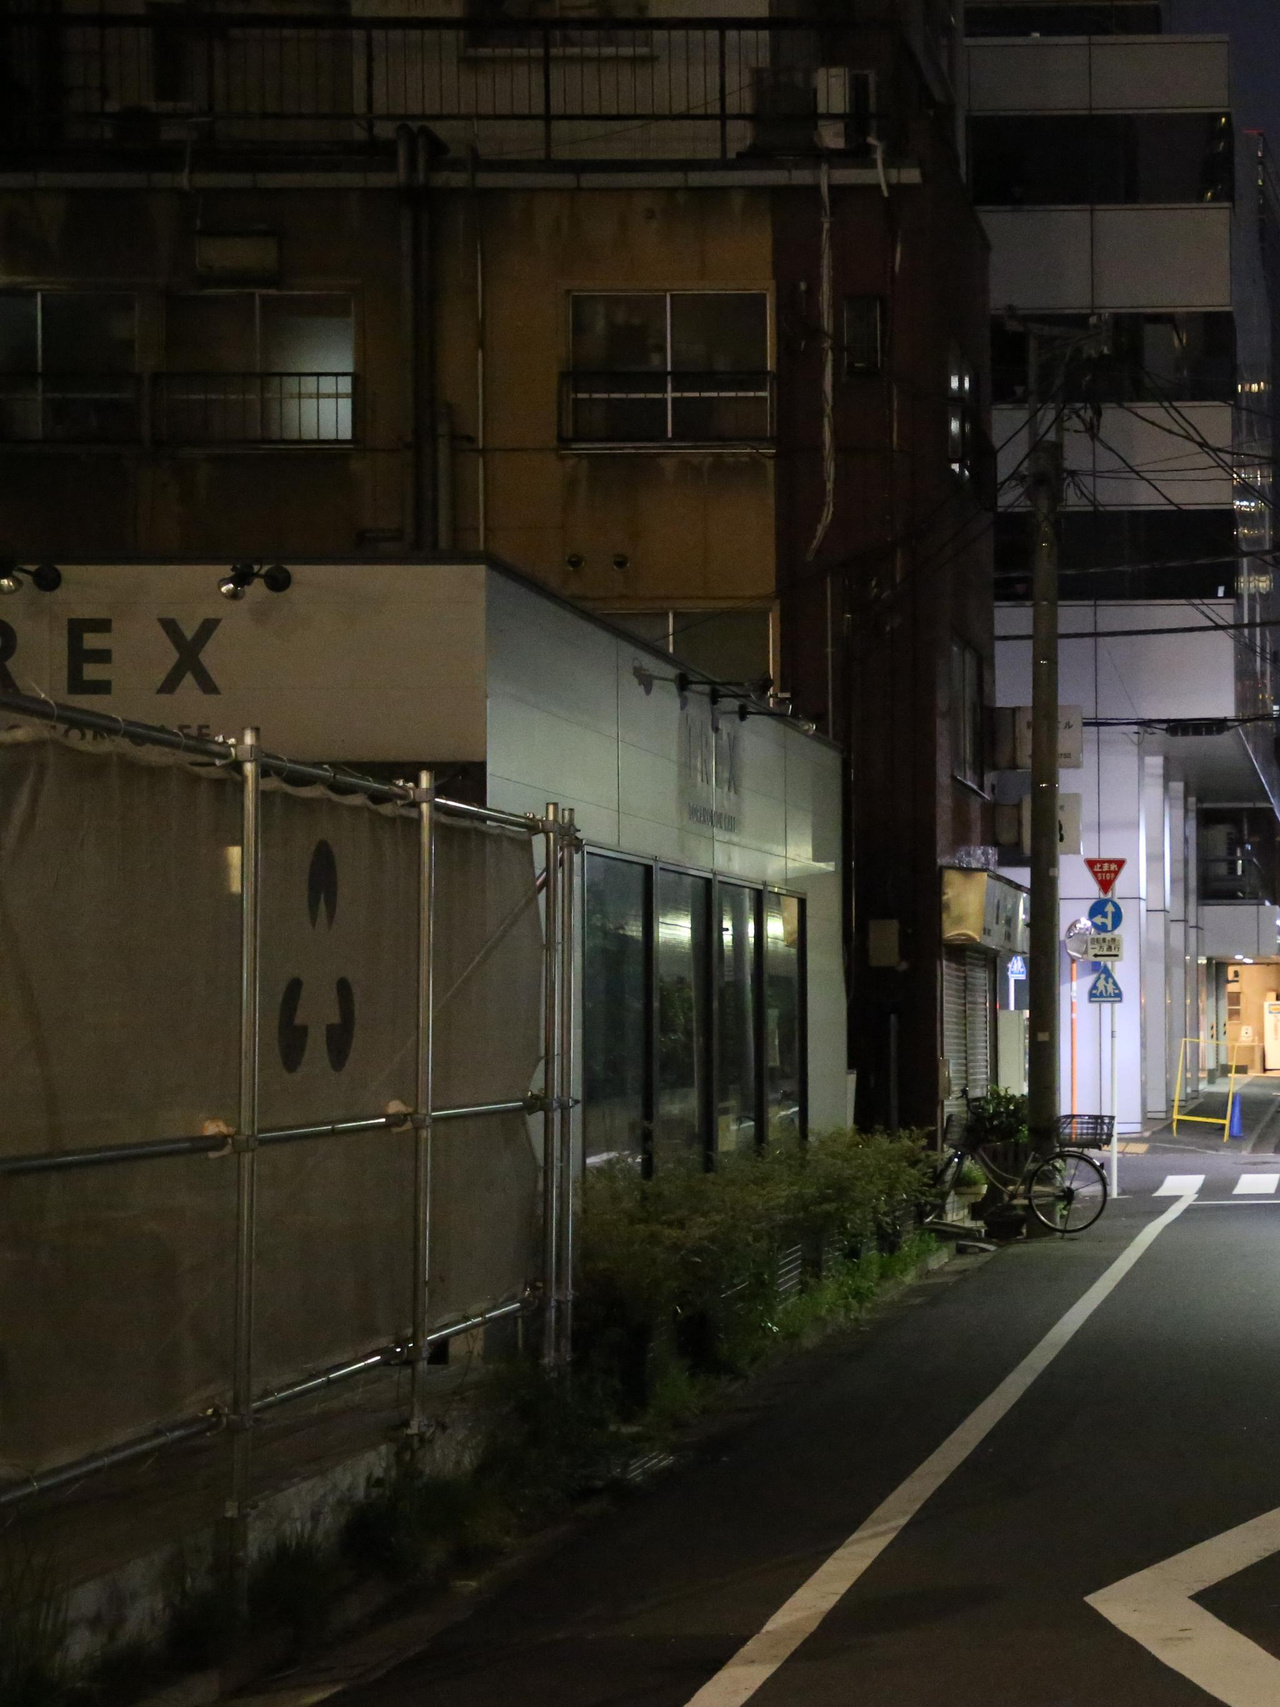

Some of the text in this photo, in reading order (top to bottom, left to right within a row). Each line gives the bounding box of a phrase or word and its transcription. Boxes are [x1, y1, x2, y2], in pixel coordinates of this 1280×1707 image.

[1093, 862, 1118, 872] 止まれ
[1097, 872, 1115, 880] STOP
